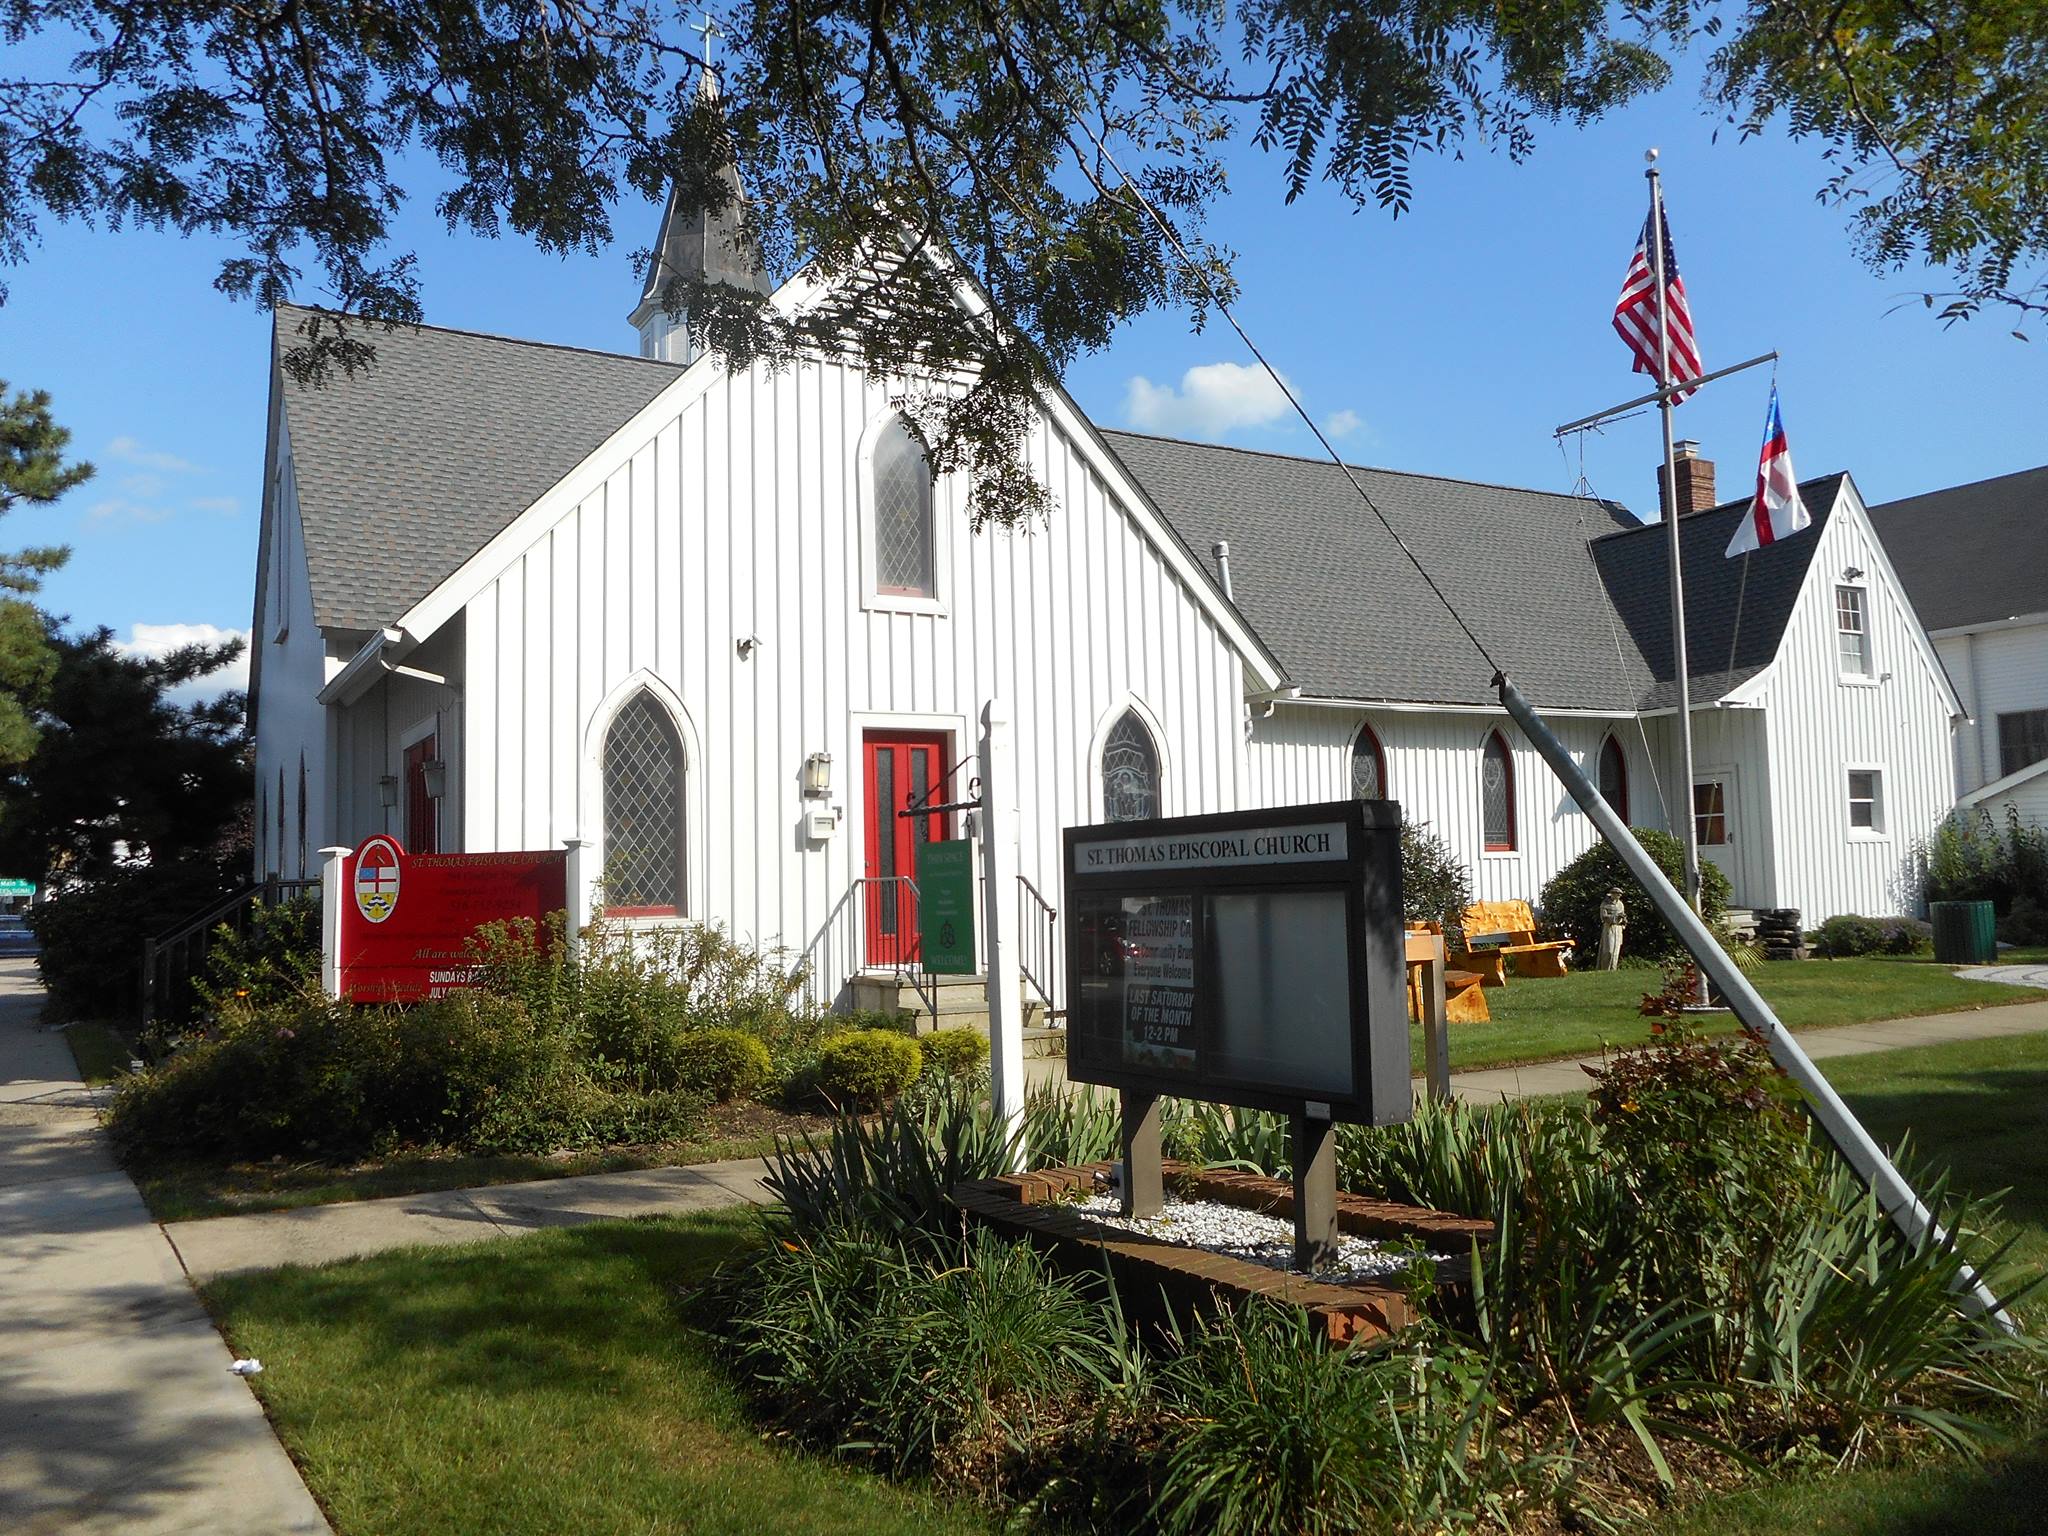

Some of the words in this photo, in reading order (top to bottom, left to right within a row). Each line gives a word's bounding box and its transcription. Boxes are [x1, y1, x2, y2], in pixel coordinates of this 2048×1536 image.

[1087, 849, 1103, 866] ST.
[1107, 842, 1165, 865] THOMAS
[1169, 838, 1250, 861] EPISCOPAL
[1254, 833, 1331, 856] CHURCH
[427, 857, 466, 868] THOMAS
[468, 855, 517, 867] EPISCOPAL
[520, 853, 561, 864] CHURCH
[1128, 920, 1178, 938] FELLOWSHIP
[412, 949, 430, 960] All
[432, 951, 447, 959] are
[429, 970, 466, 983] SUNDAYS
[1163, 964, 1192, 980] Welcome
[429, 987, 447, 999] JULY
[1129, 988, 1151, 1004] LAST
[1151, 990, 1195, 1008] SATURDAY
[1131, 1006, 1143, 1021] OF
[1144, 1007, 1160, 1023] THE
[1161, 1008, 1192, 1026] MONTH
[1144, 1024, 1163, 1041] 12-2
[1164, 1027, 1179, 1043] PM
